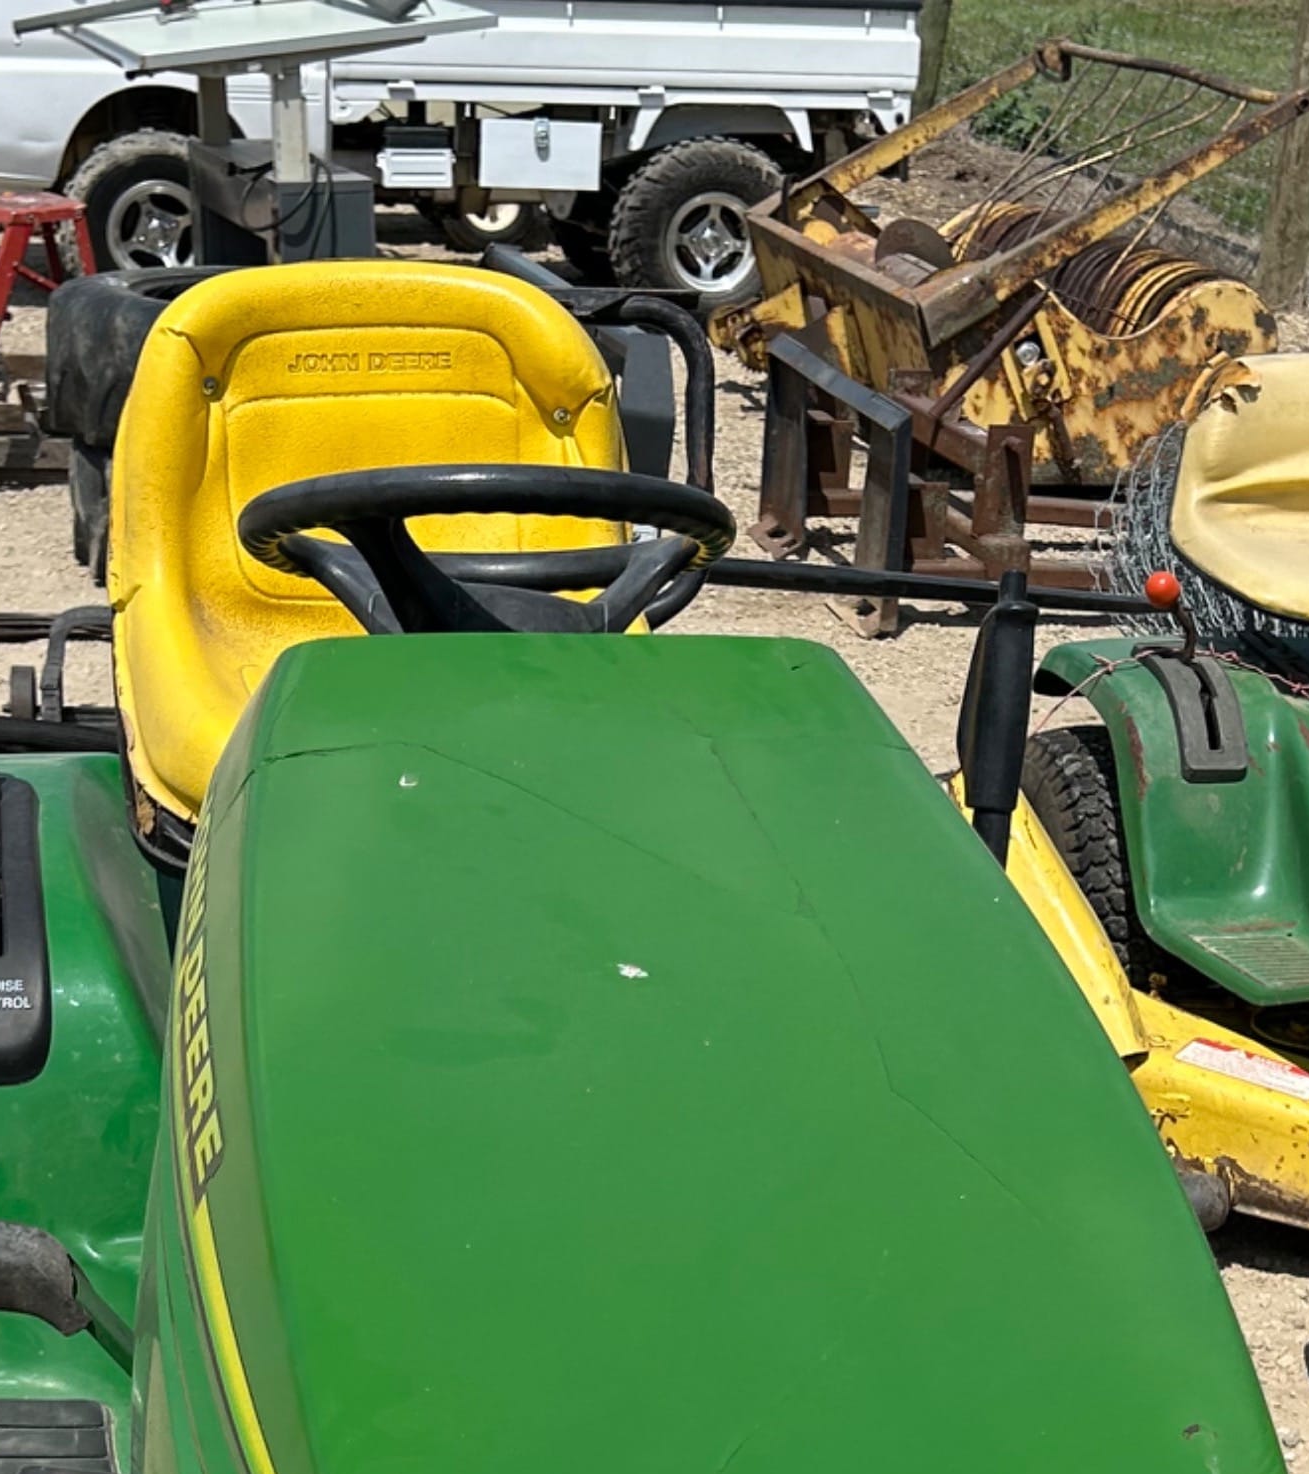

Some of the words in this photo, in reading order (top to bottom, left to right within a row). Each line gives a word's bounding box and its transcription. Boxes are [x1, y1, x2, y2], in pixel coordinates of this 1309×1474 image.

[287, 352, 360, 374] JOHN
[368, 352, 452, 373] DEERE
[183, 935, 224, 1185] DEERE
